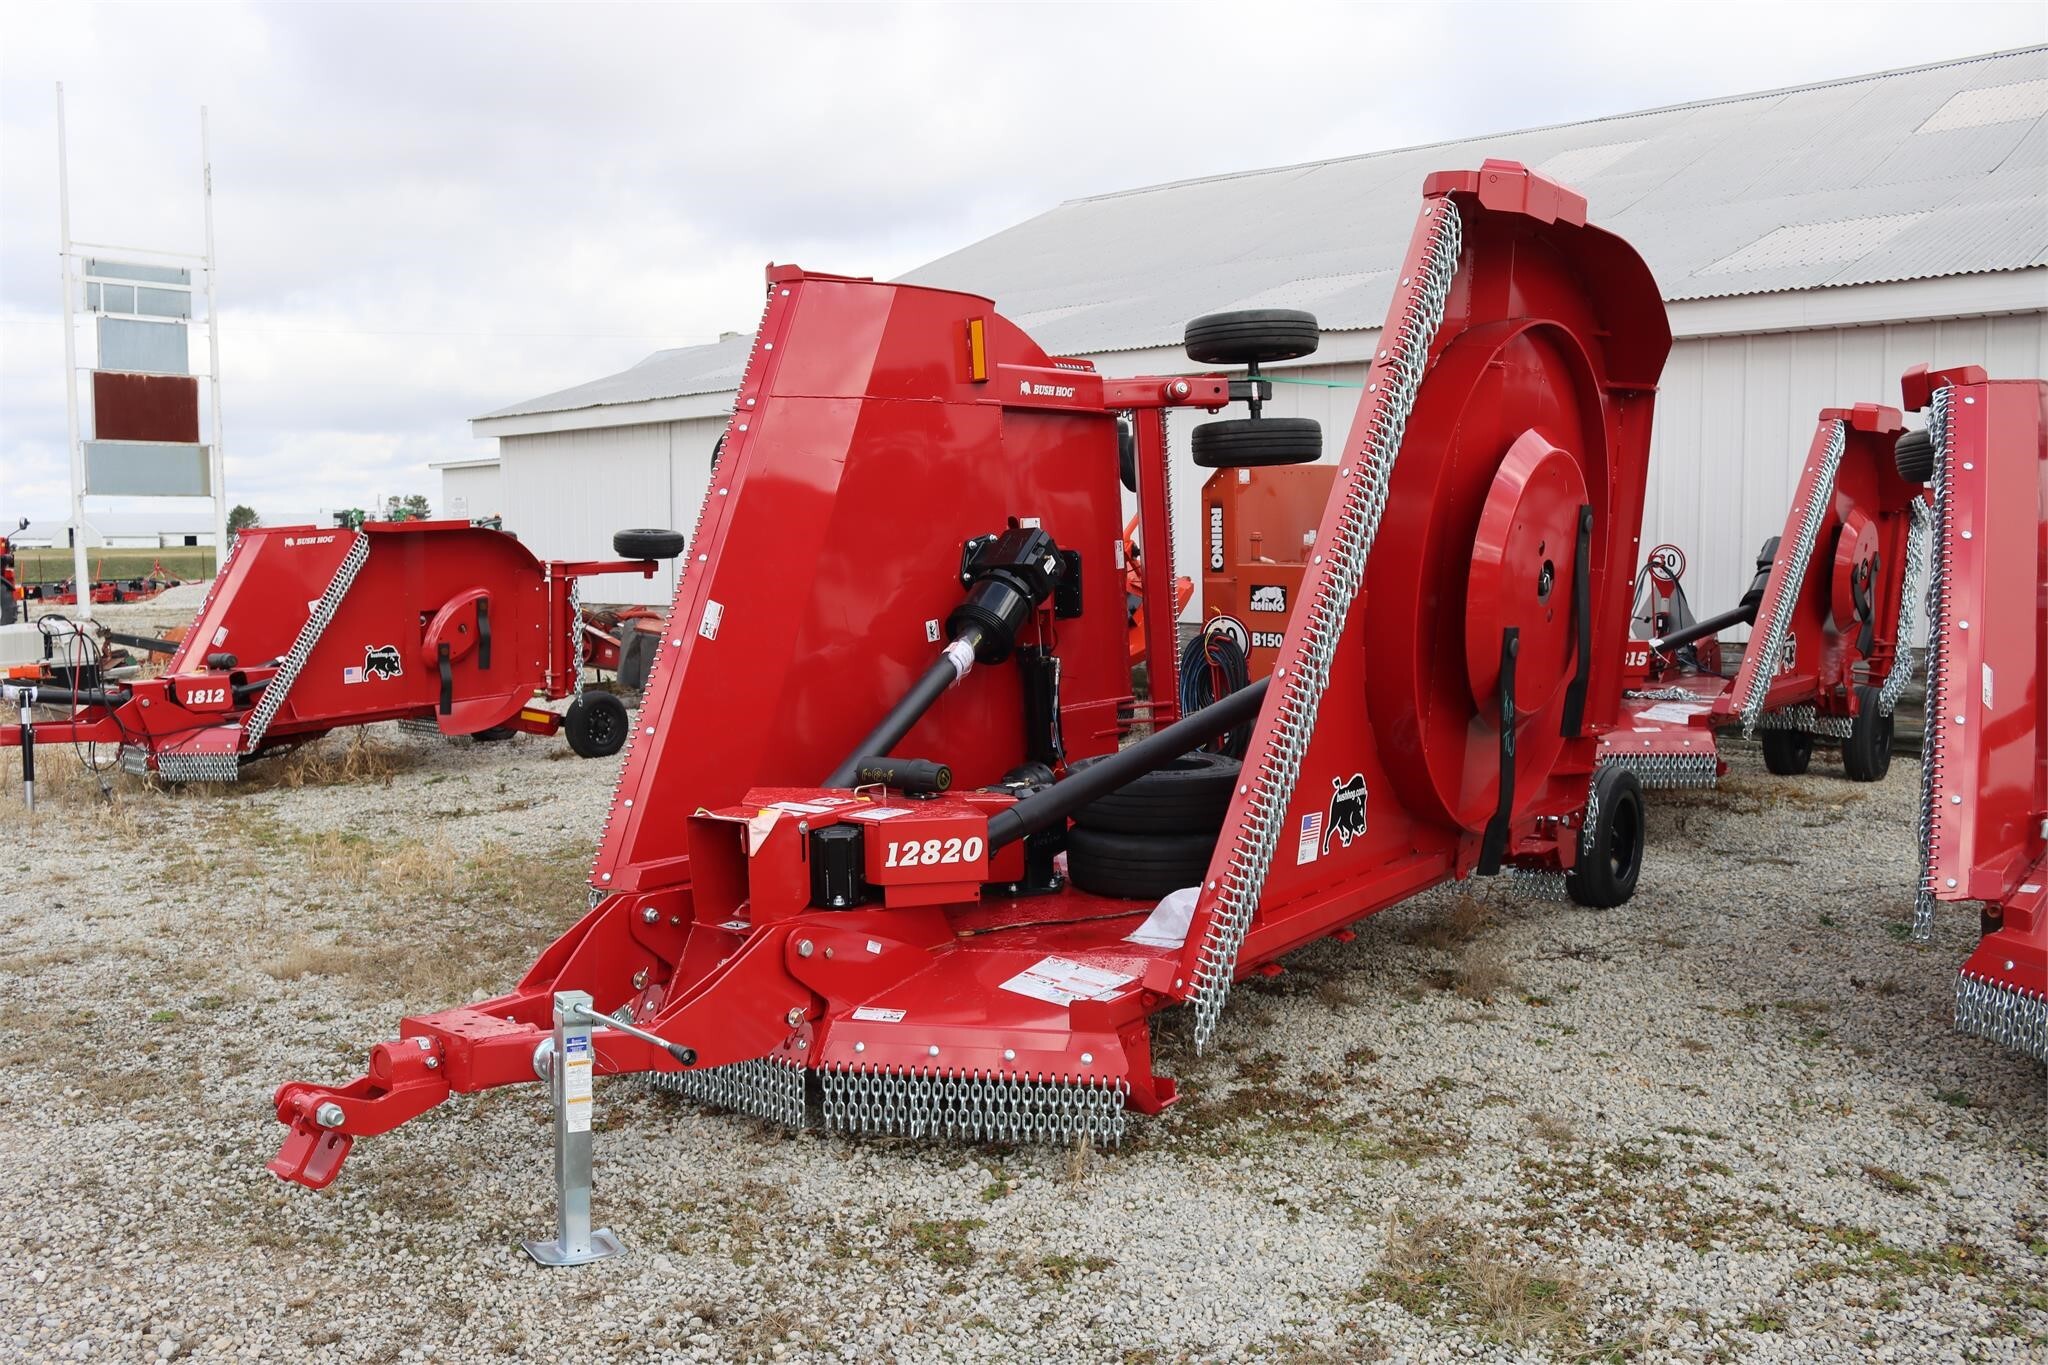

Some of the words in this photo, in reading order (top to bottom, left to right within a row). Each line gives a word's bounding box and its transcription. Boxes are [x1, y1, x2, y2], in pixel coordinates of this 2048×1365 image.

[1033, 384, 1055, 396] BUSH
[1055, 386, 1073, 398] HOG
[296, 537, 316, 545] BUSH
[1210, 508, 1223, 569] RHINO
[1252, 632, 1283, 648] B150
[1625, 652, 1648, 667] 15
[186, 688, 225, 704] 1812
[1336, 787, 1366, 803] bushhog.com
[885, 836, 983, 867] 12820
